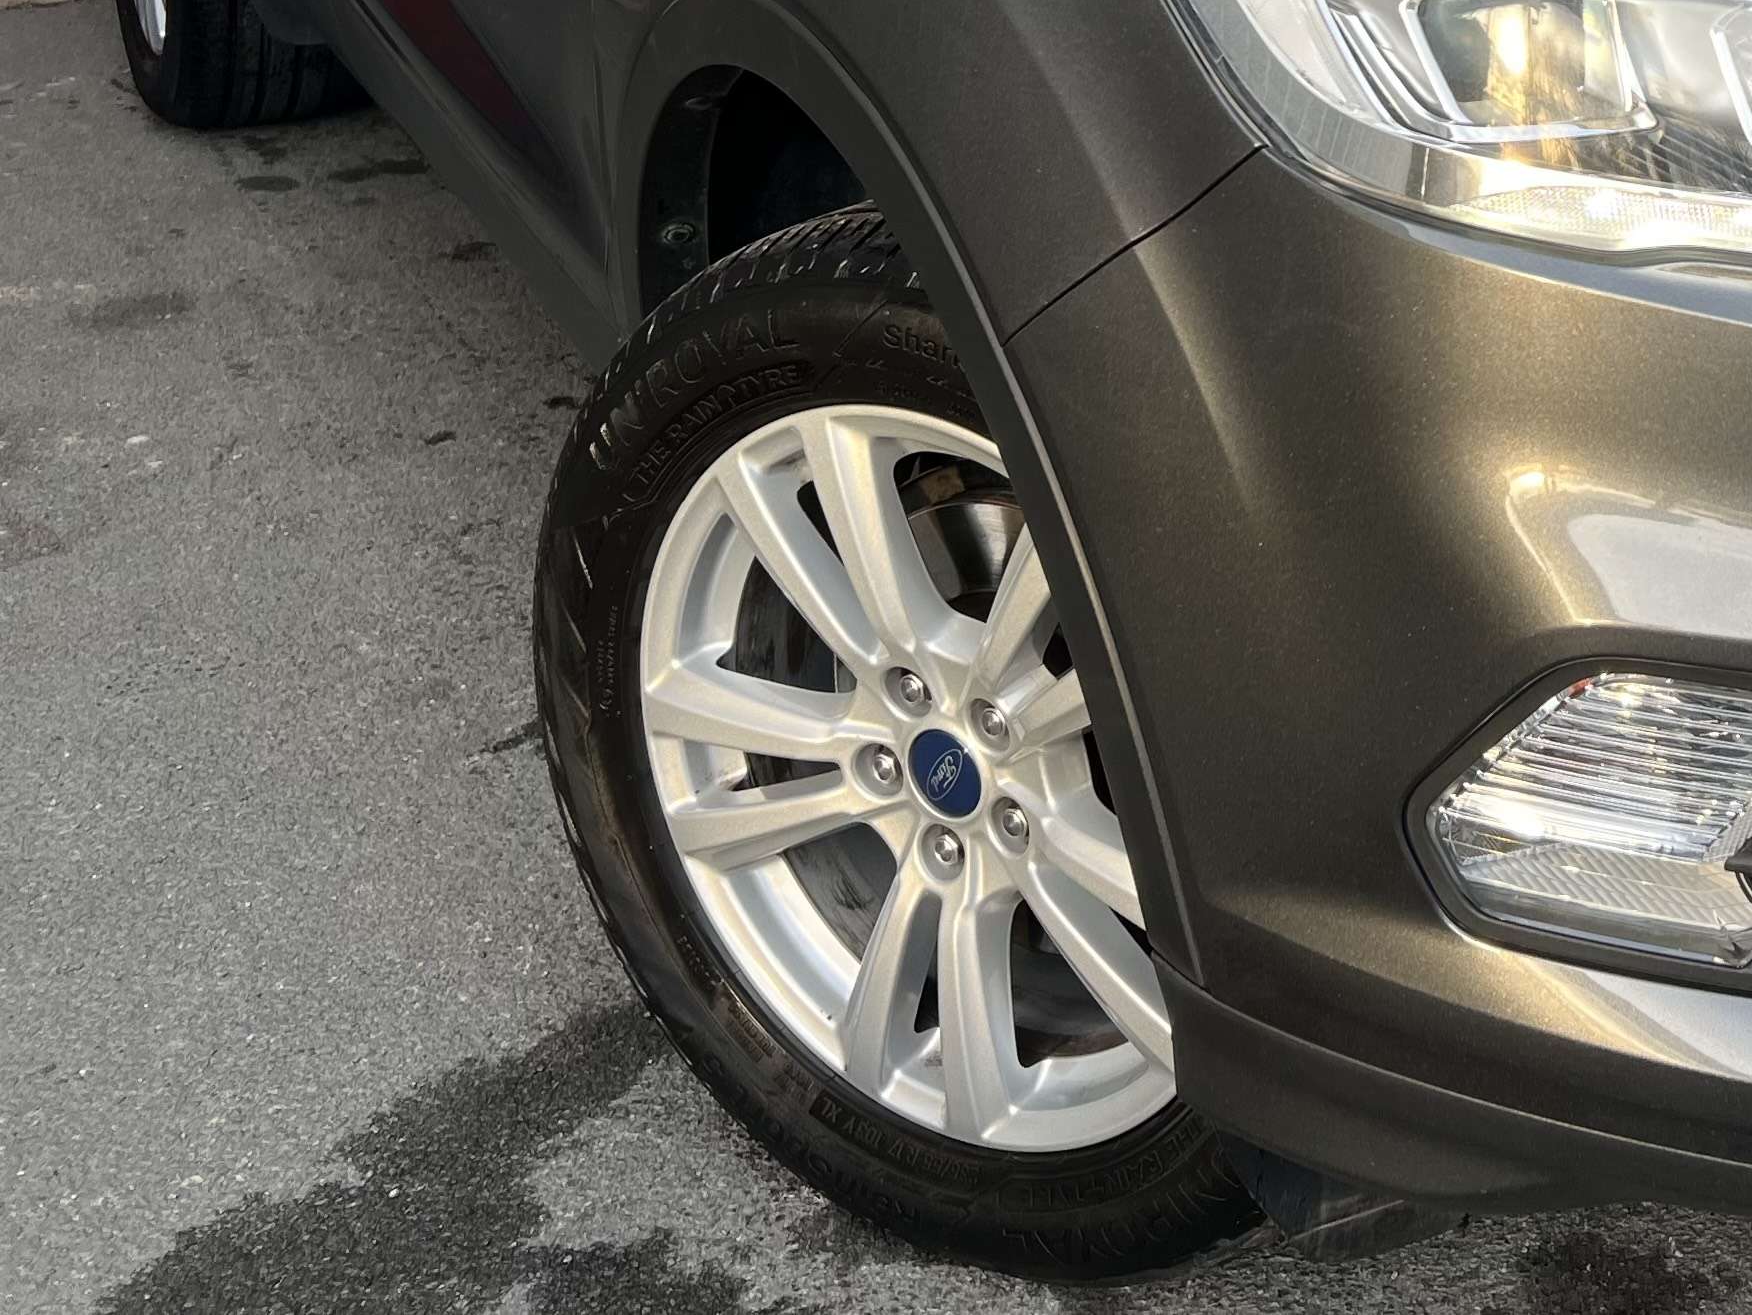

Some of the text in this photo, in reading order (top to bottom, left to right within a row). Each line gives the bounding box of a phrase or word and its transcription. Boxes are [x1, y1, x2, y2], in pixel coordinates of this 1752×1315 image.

[588, 308, 801, 471] UNIROYAL
[627, 364, 804, 487] THE RAIN TYRE
[930, 755, 957, 793] Ford
[818, 1096, 843, 1124] XL
